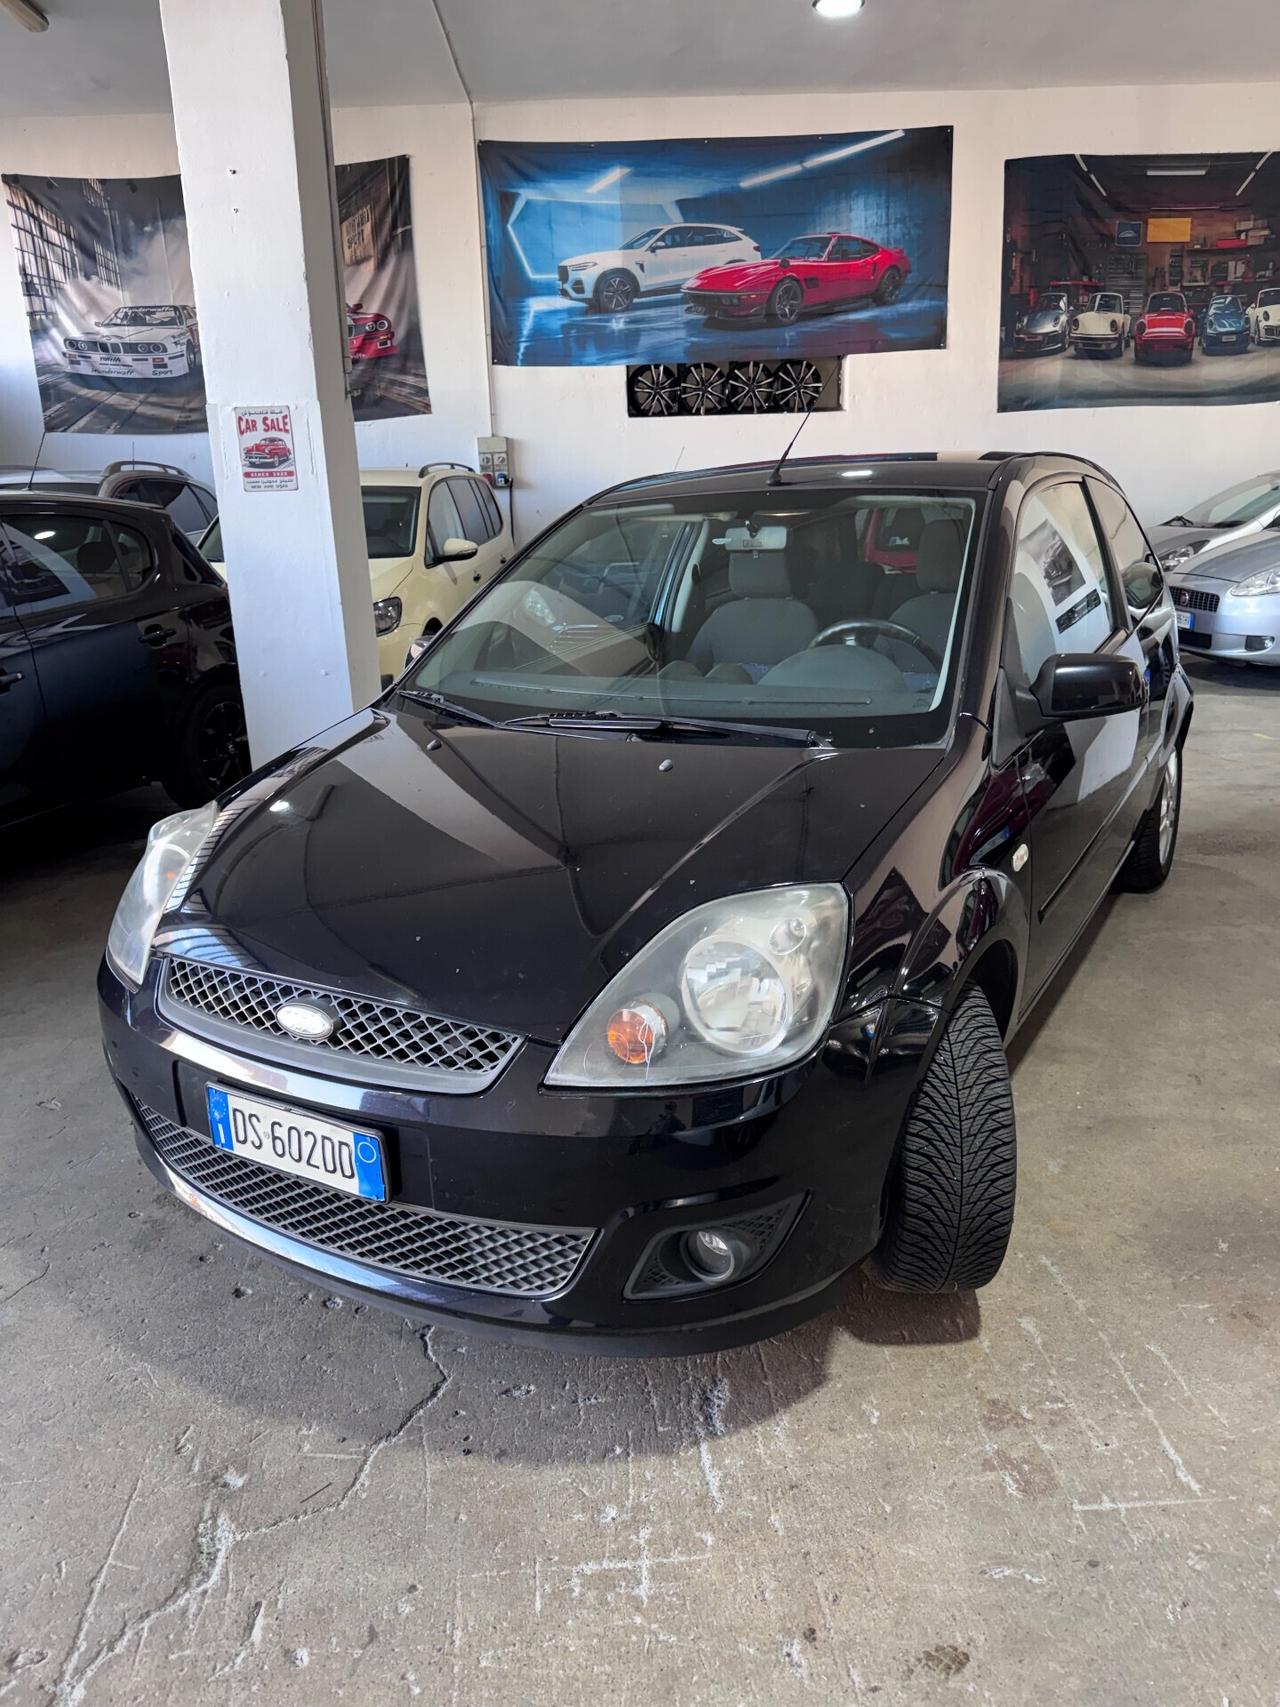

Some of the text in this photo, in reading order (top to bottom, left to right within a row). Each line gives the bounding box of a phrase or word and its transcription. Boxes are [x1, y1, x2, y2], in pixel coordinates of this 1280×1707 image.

[238, 414, 290, 436] CAR SALE
[232, 1108, 263, 1150] DS
